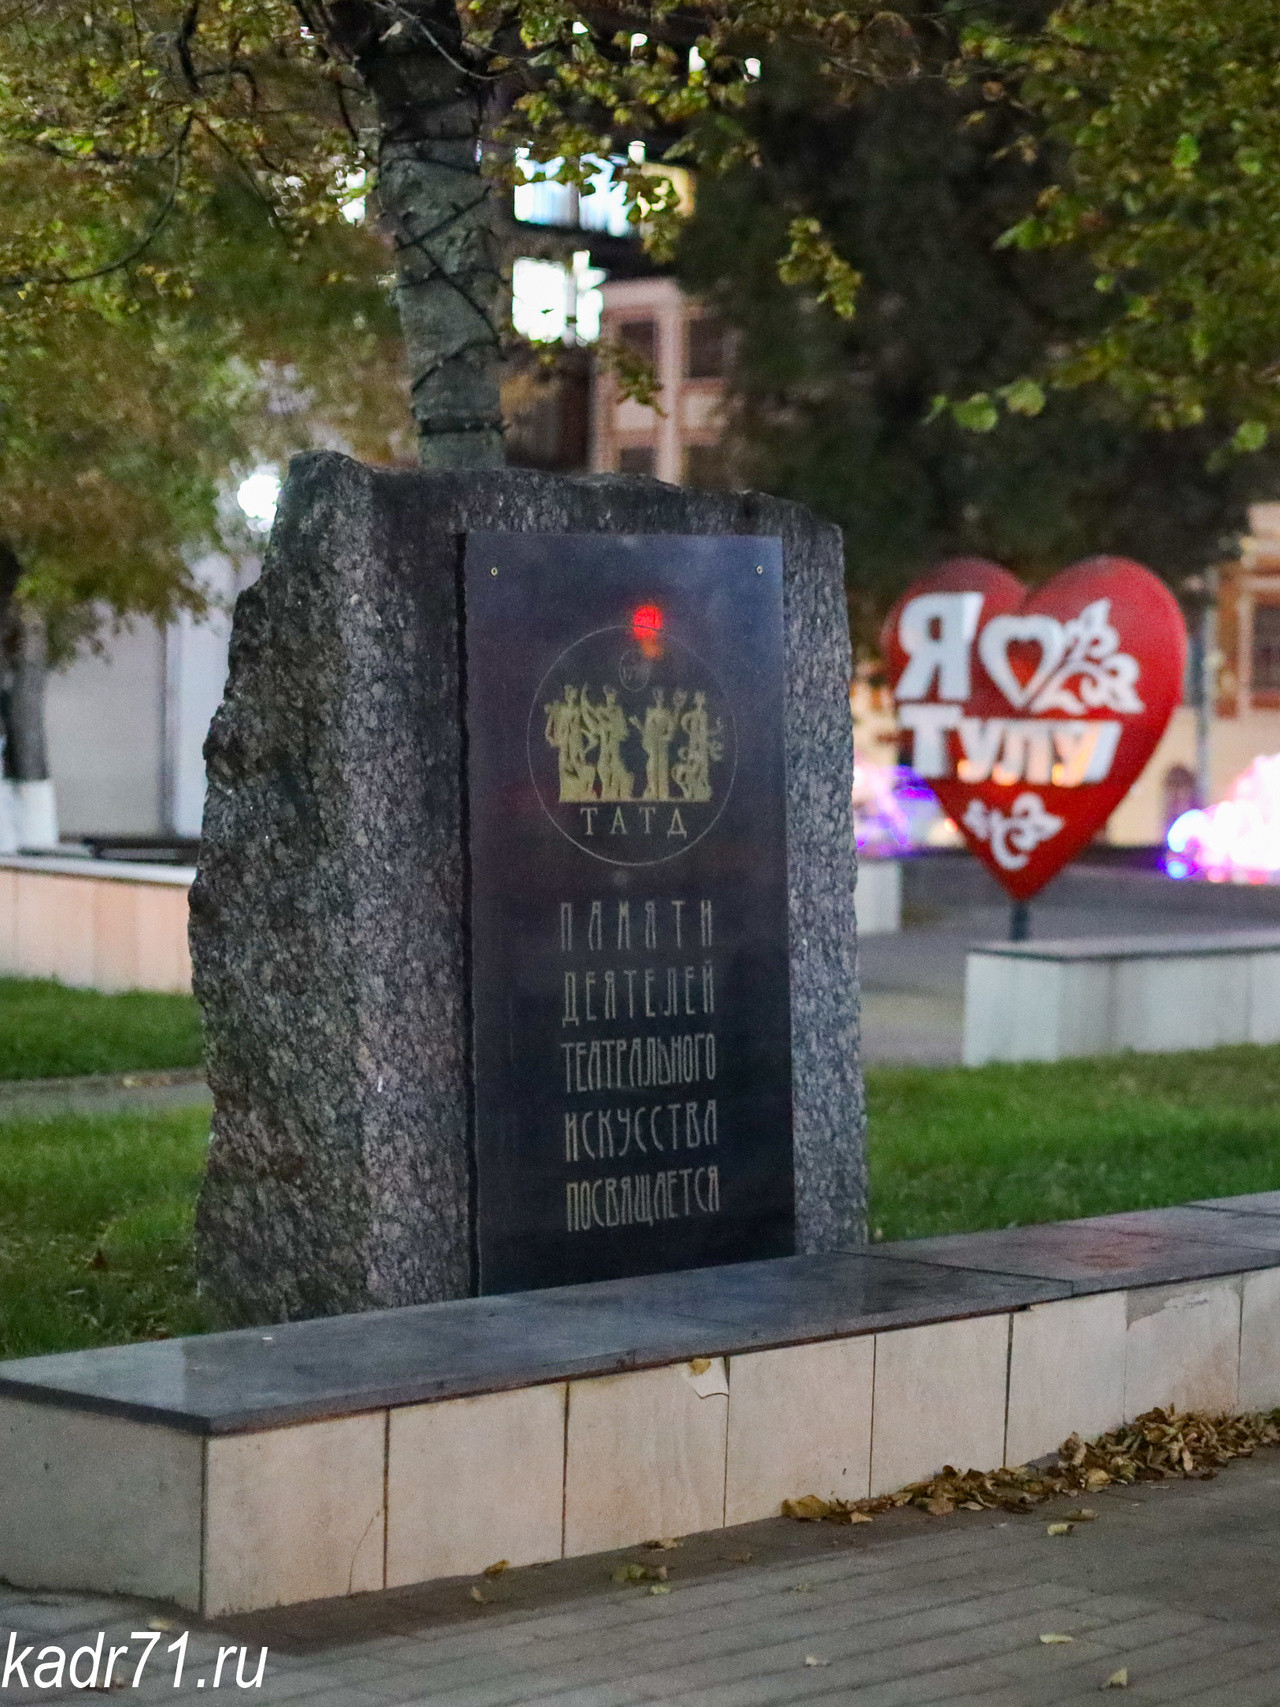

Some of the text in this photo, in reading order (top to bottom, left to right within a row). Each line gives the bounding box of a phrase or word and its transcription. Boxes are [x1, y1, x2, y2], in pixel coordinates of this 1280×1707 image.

[897, 592, 985, 700] Я
[579, 806, 688, 838] ТАТД
[560, 900, 713, 951] ПАМЯТИ
[562, 959, 715, 1027] ДЕЯТЕЛЕЙ
[561, 1032, 717, 1093] ТЕАТРАЛЬНОГО
[564, 1099, 718, 1163] ИСКУССТВА
[566, 1165, 720, 1233] ПОСВЯЩАЕТСЯ
